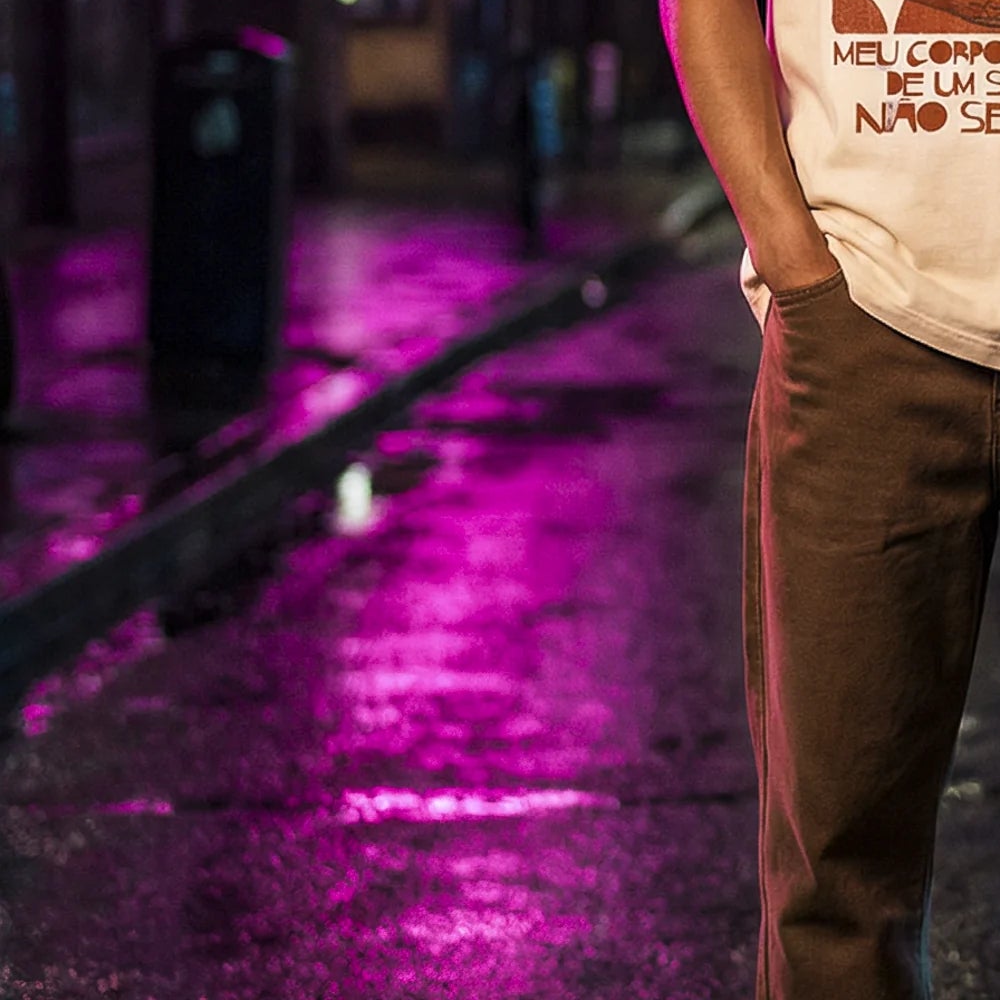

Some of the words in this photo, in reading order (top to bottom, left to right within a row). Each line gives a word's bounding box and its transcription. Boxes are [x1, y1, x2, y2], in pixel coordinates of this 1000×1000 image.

[833, 40, 899, 66] MEU
[886, 71, 924, 96] DE
[934, 71, 975, 97] UM
[855, 97, 948, 134] NÃO
